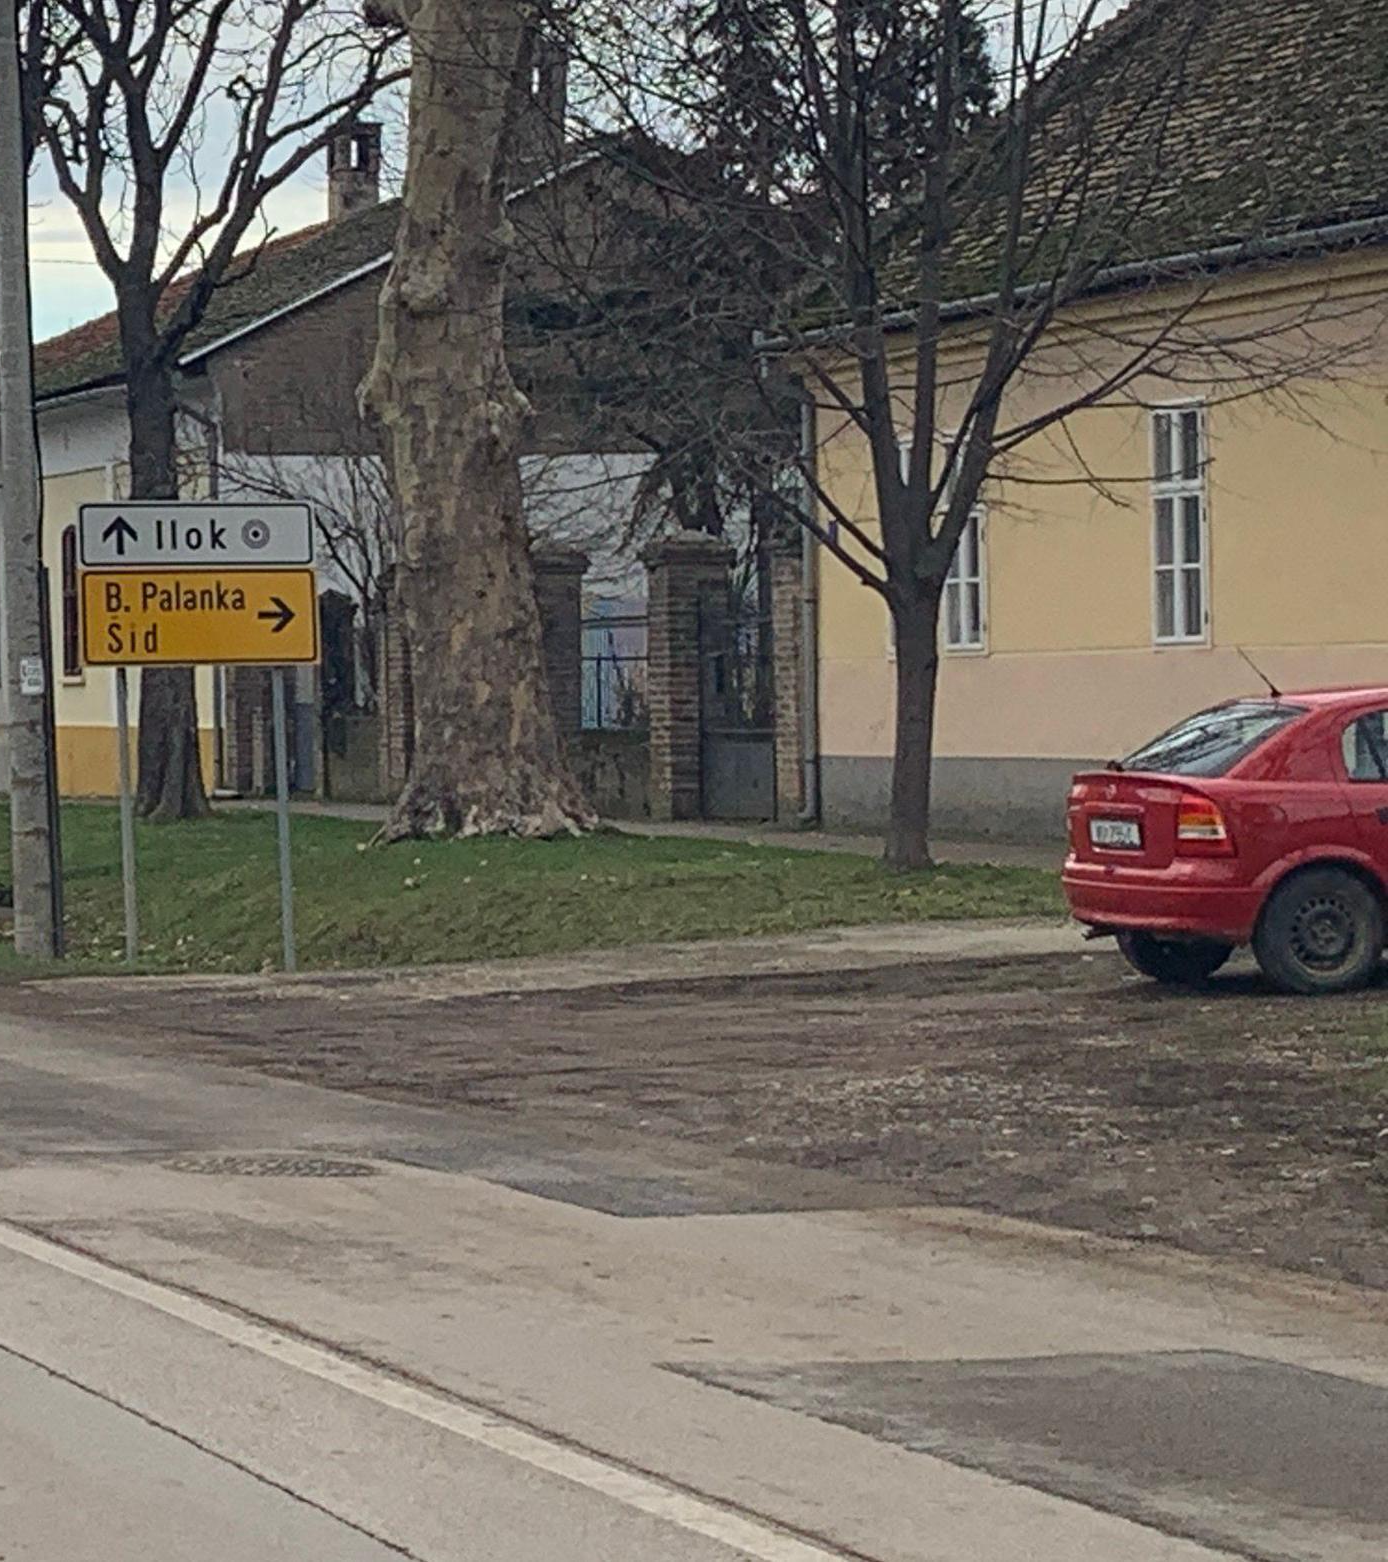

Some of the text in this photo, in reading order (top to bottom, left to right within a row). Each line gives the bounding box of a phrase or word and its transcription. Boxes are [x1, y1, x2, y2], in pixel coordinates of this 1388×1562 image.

[156, 519, 227, 550] Ilok
[105, 580, 246, 613] B. Palanka
[107, 614, 158, 654] Šid
